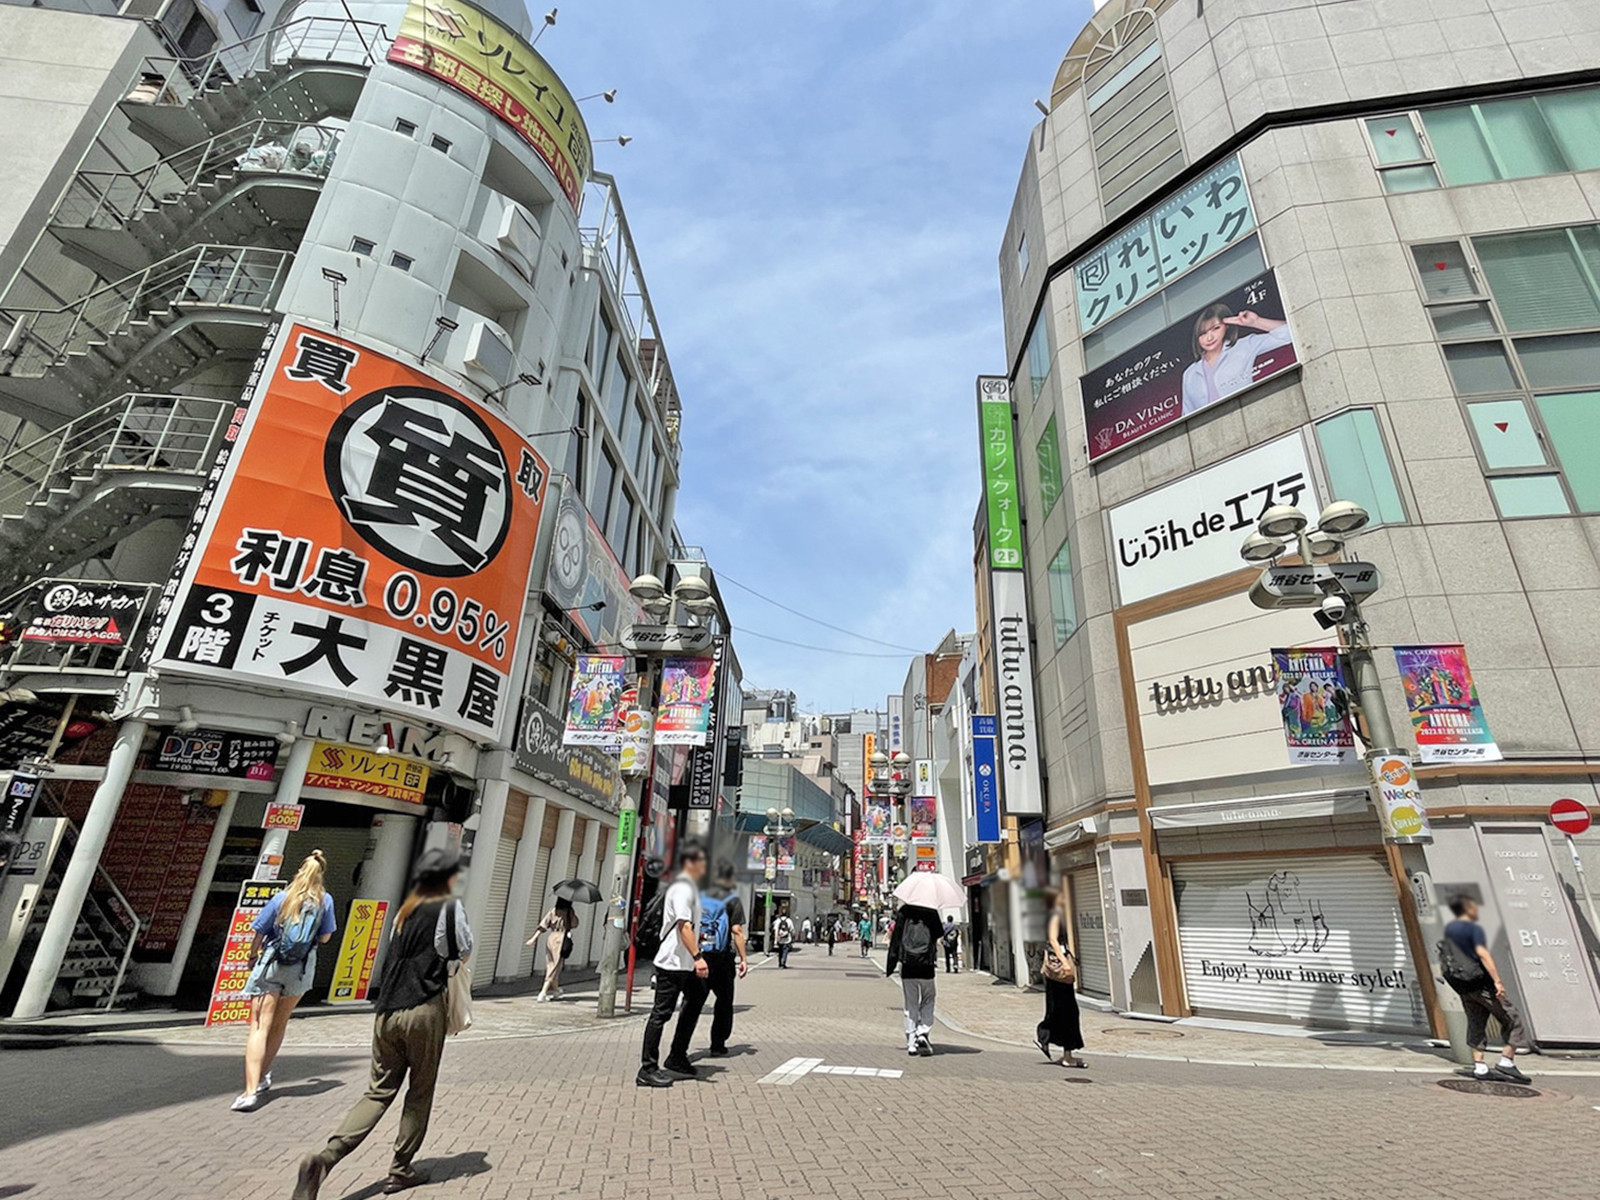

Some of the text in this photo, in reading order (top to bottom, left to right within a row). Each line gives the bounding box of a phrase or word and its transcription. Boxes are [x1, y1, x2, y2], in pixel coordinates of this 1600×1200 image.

[477, 30, 565, 132] ソレイユ
[1117, 176, 1242, 268] れいわ
[1086, 206, 1248, 326] クリニック
[1246, 289, 1267, 305] 4F
[284, 335, 359, 393] 買
[1105, 351, 1163, 388] あなたのクマ
[1094, 357, 1181, 409] 私にご相談ください
[1115, 394, 1180, 434] DA VINCI
[1122, 409, 1175, 439] BEAUTY CLINIC
[514, 448, 545, 504] 取
[988, 427, 1013, 543] カワノ・クォーク
[998, 550, 1015, 562] 2F
[231, 527, 512, 661] 利息 0.95%
[178, 592, 234, 664] 3階
[252, 611, 281, 661] チケット
[279, 614, 501, 729] 大黒屋
[1429, 712, 1470, 727] ANTENNA
[161, 736, 223, 761] DPS
[243, 750, 273, 758] カラオケ
[350, 754, 400, 781] ソレイユ
[405, 774, 419, 787] 6F
[982, 779, 991, 813] OKURA
[268, 815, 298, 825] 500円
[1504, 866, 1515, 881] 1
[342, 925, 365, 979] ソレイユ
[1518, 929, 1541, 946] B1
[1200, 959, 1407, 993] Enjoy! your inner style!!
[211, 1008, 250, 1021] 500円
